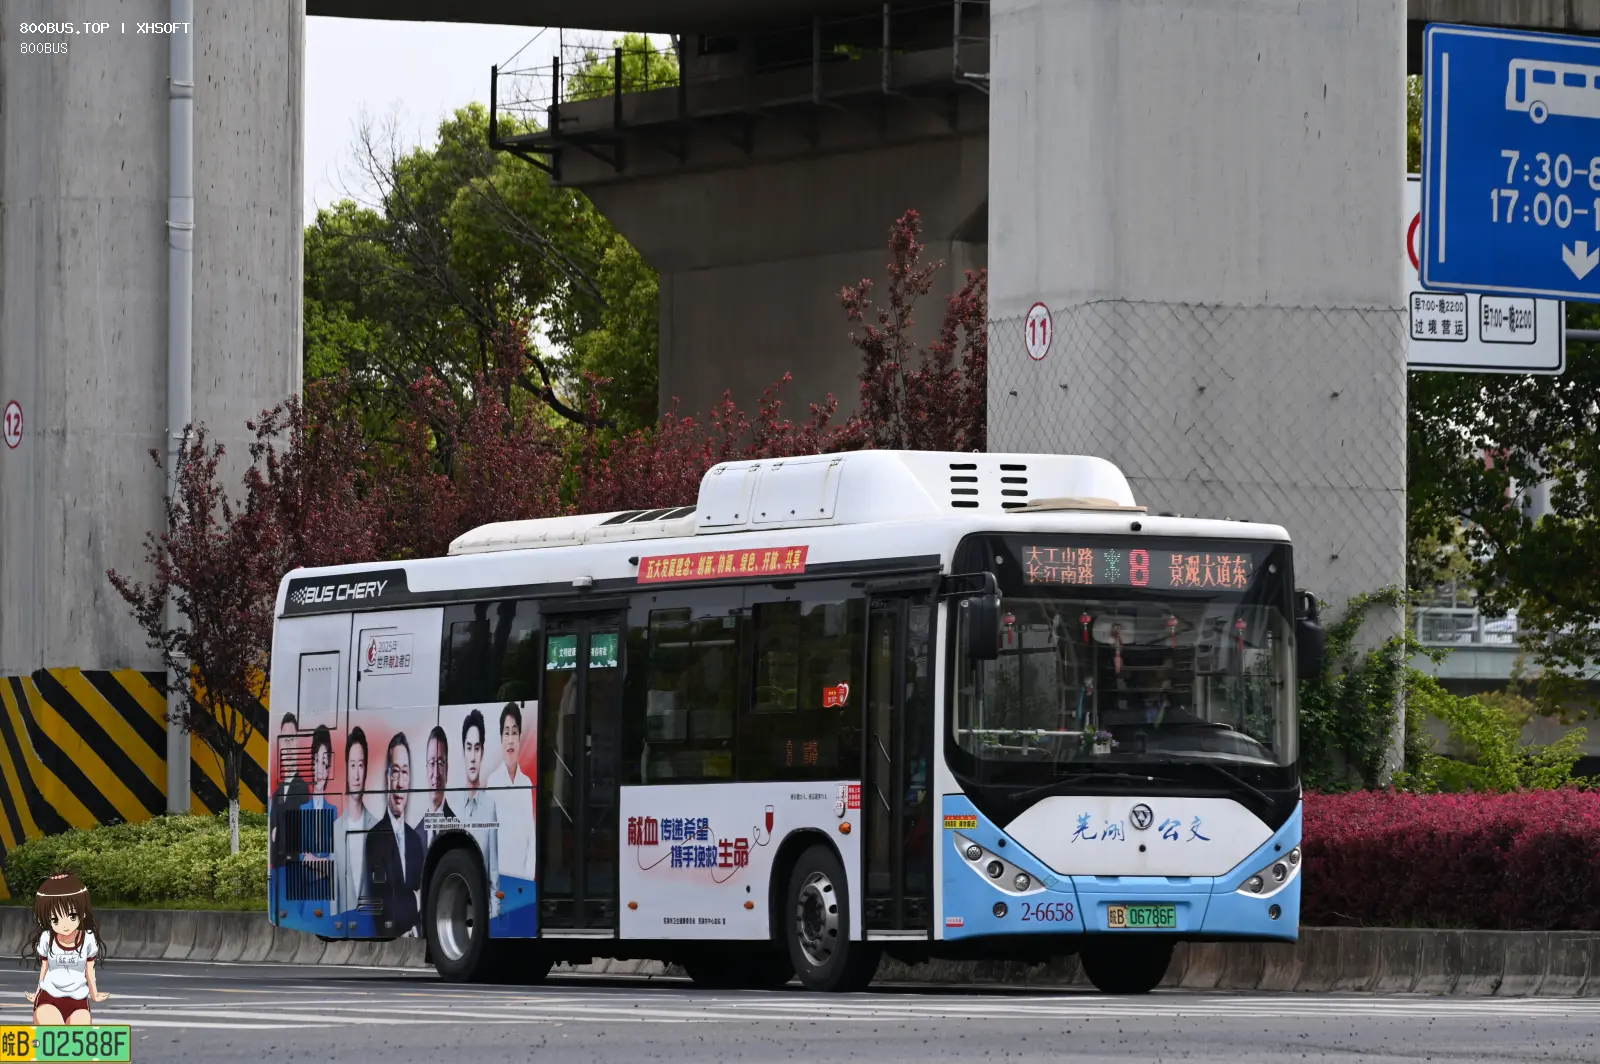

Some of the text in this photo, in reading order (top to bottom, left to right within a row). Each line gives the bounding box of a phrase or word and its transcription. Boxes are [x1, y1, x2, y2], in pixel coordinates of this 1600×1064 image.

[1029, 317, 1047, 346] 11
[1415, 319, 1464, 336] 过境营运
[6, 413, 20, 436] 12
[1026, 545, 1094, 565] 大工山路
[1026, 564, 1094, 585] 长江南路
[1129, 549, 1150, 587] 8
[1168, 553, 1248, 588] 景观大道东
[304, 580, 388, 604] BUS CHERY
[378, 640, 398, 653] 2025年
[377, 654, 411, 669] 世界献血者日
[1071, 812, 1211, 843] 芜湖 公交
[1021, 902, 1074, 922] 2-6658
[1109, 907, 1174, 925] 皖B 06786F
